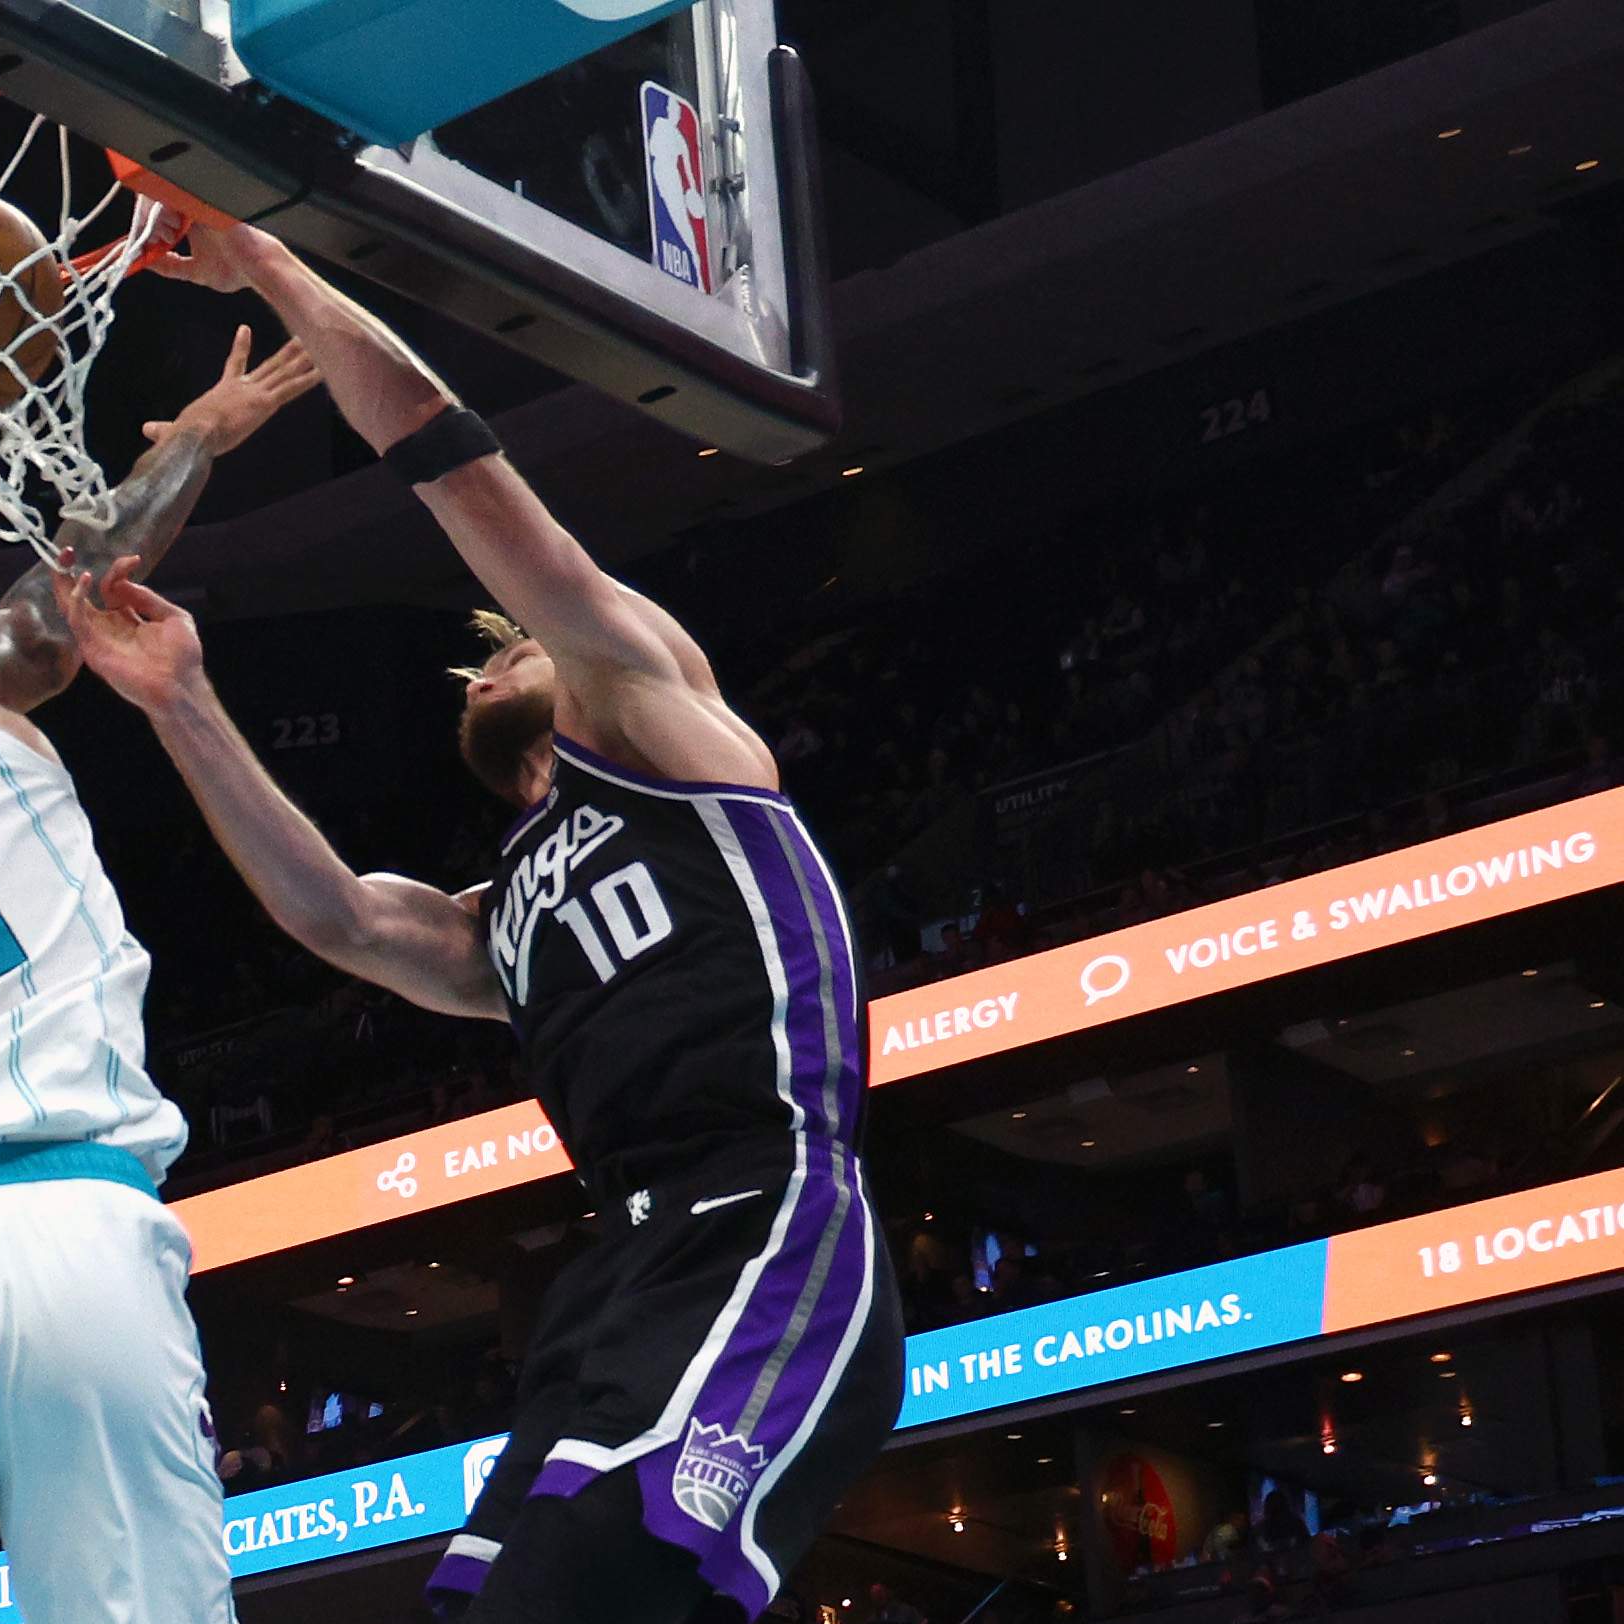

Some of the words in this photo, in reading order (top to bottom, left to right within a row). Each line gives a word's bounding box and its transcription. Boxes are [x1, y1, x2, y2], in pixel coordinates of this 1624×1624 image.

[663, 241, 692, 284] NBA
[1200, 390, 1273, 444] 224
[271, 712, 340, 750] 223
[489, 804, 625, 1006] Kings
[554, 862, 673, 983] 10
[1165, 920, 1278, 975] VOICE
[1291, 910, 1319, 942] &
[1329, 831, 1597, 932] SWALLOWING
[882, 992, 1019, 1056] ALLERGY
[444, 1143, 499, 1179] EAR
[1417, 1243, 1463, 1279] 18
[911, 1360, 951, 1397] IN
[959, 1344, 1023, 1385] THE
[1033, 1292, 1254, 1368] CAROLINAS.
[353, 1470, 427, 1522] P.A.
